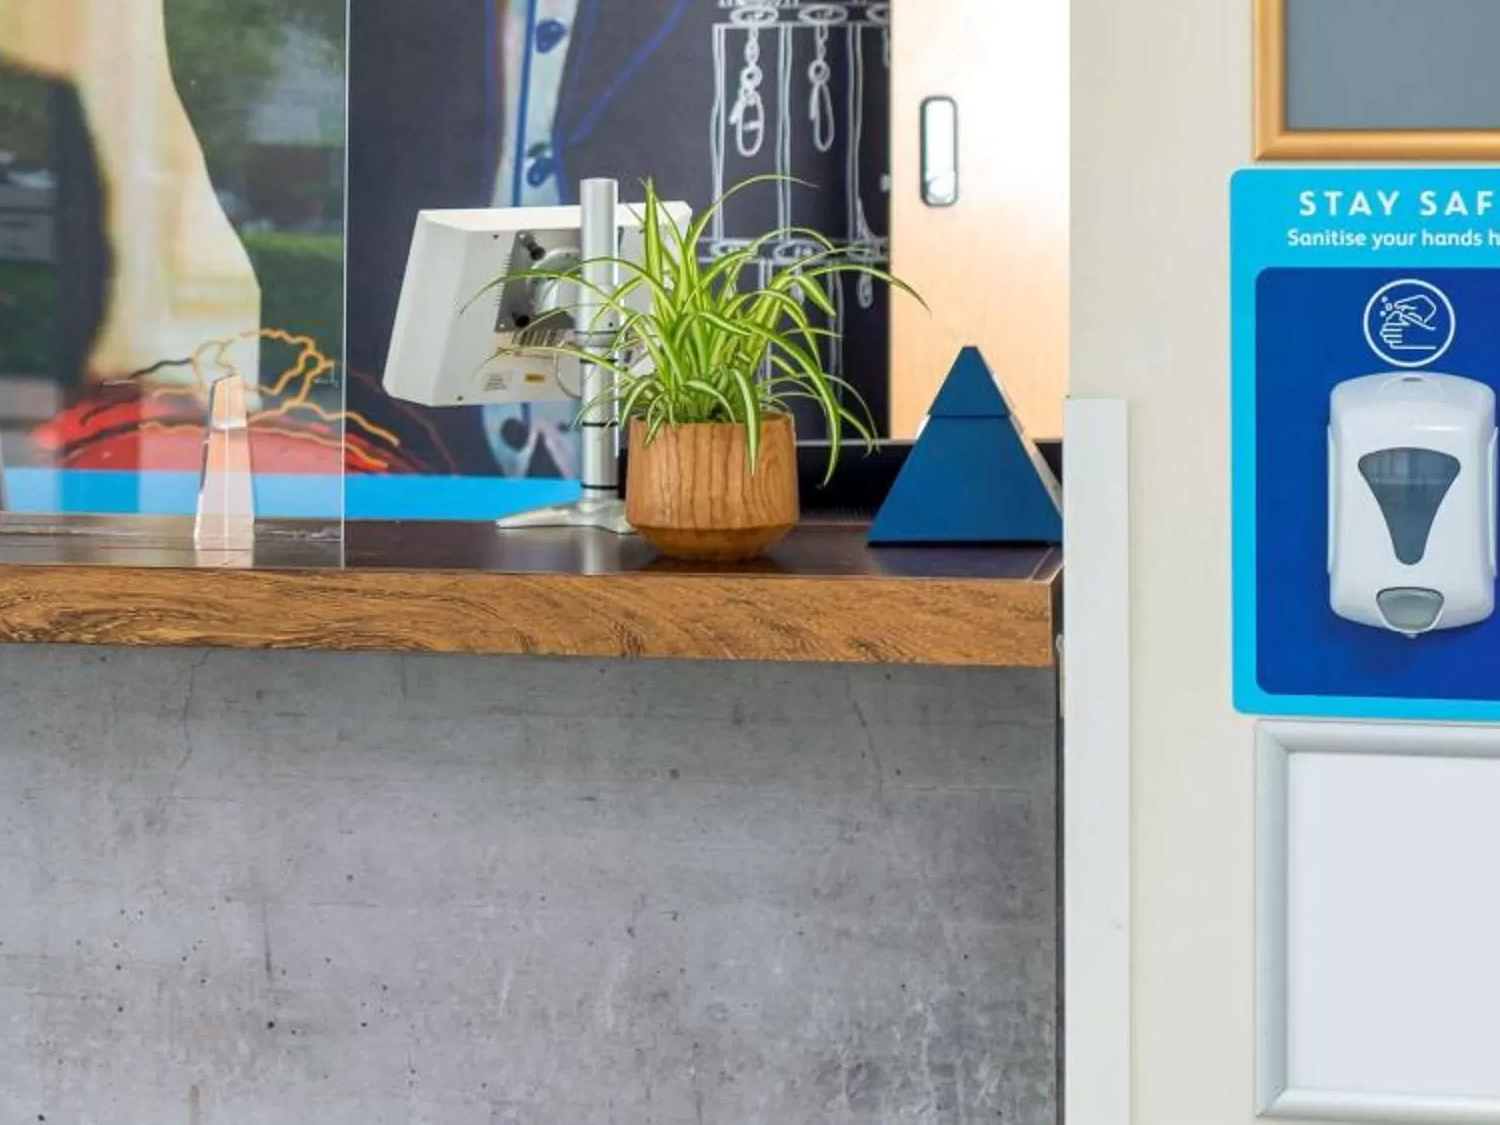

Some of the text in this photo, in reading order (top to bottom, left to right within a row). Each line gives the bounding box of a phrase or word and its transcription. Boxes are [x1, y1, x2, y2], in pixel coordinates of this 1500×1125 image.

[1299, 189, 1494, 216] STAY SAF
[1286, 228, 1367, 247] Sanitise
[1371, 231, 1416, 251] your
[1421, 228, 1483, 247] hands
